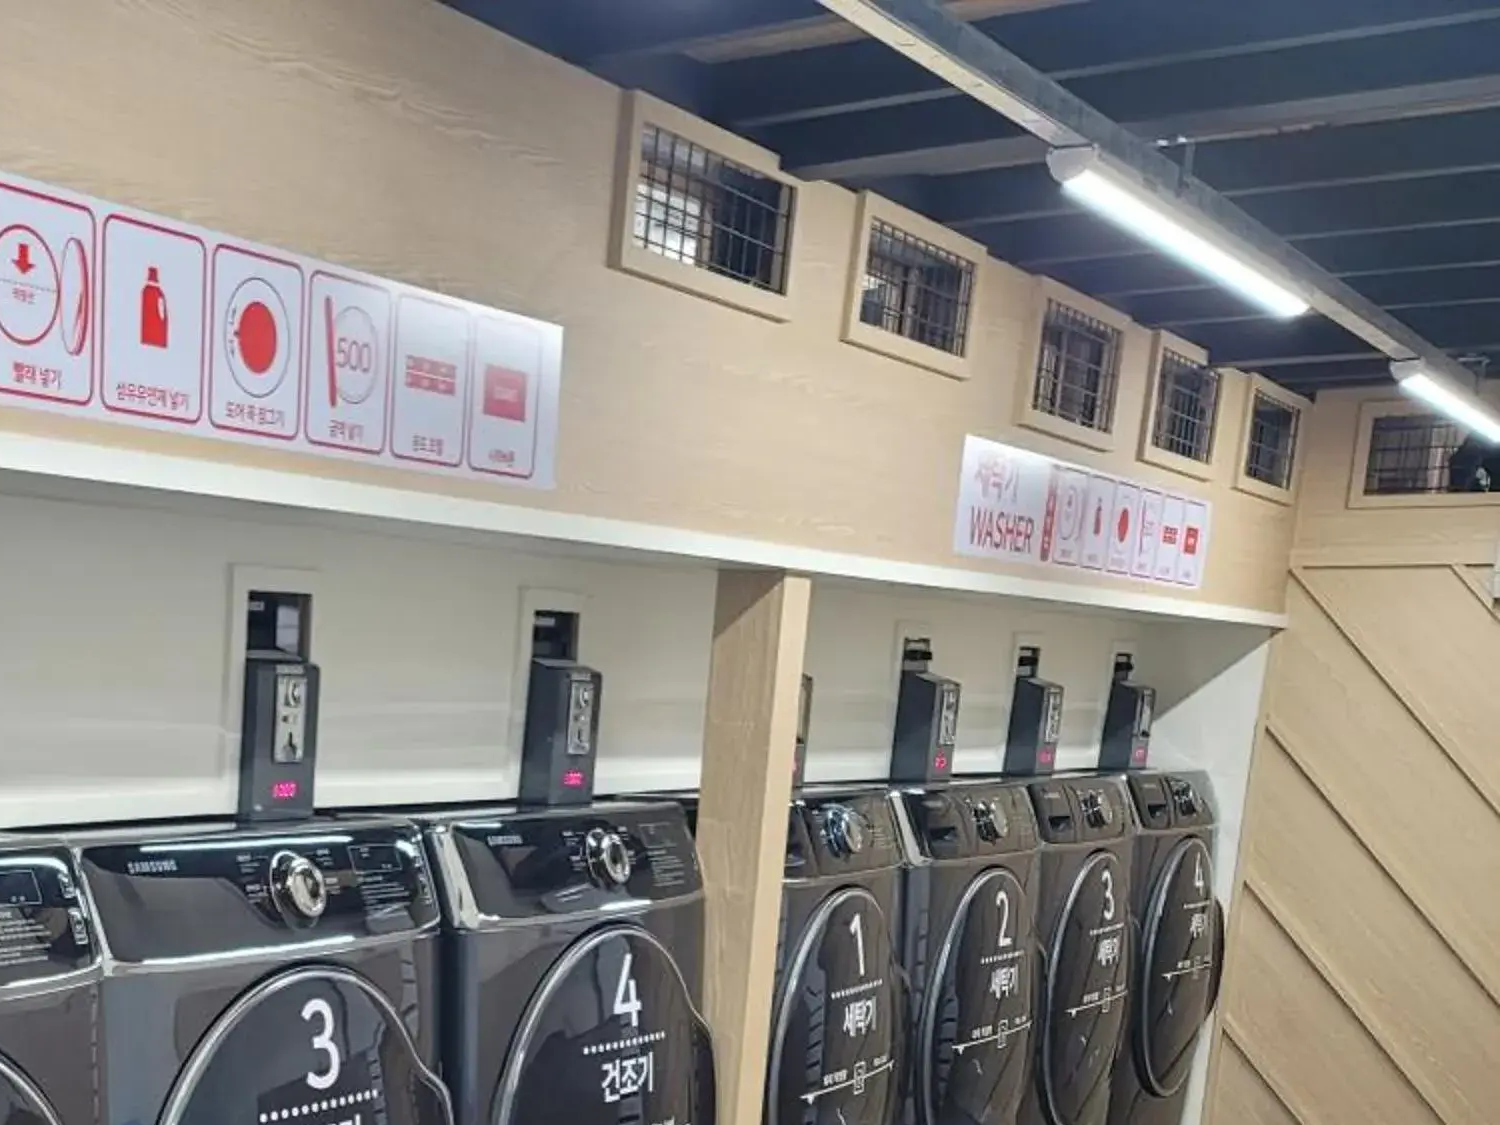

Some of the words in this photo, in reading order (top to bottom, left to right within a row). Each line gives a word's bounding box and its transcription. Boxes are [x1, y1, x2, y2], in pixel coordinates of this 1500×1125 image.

[336, 337, 372, 374] 500
[970, 505, 1035, 554] WASHER
[996, 891, 1012, 946] 2
[1101, 869, 1115, 920] 3
[850, 913, 864, 976] 1
[614, 953, 641, 1026] 4
[301, 999, 340, 1089] 3
[601, 1052, 653, 1103] 건조기
